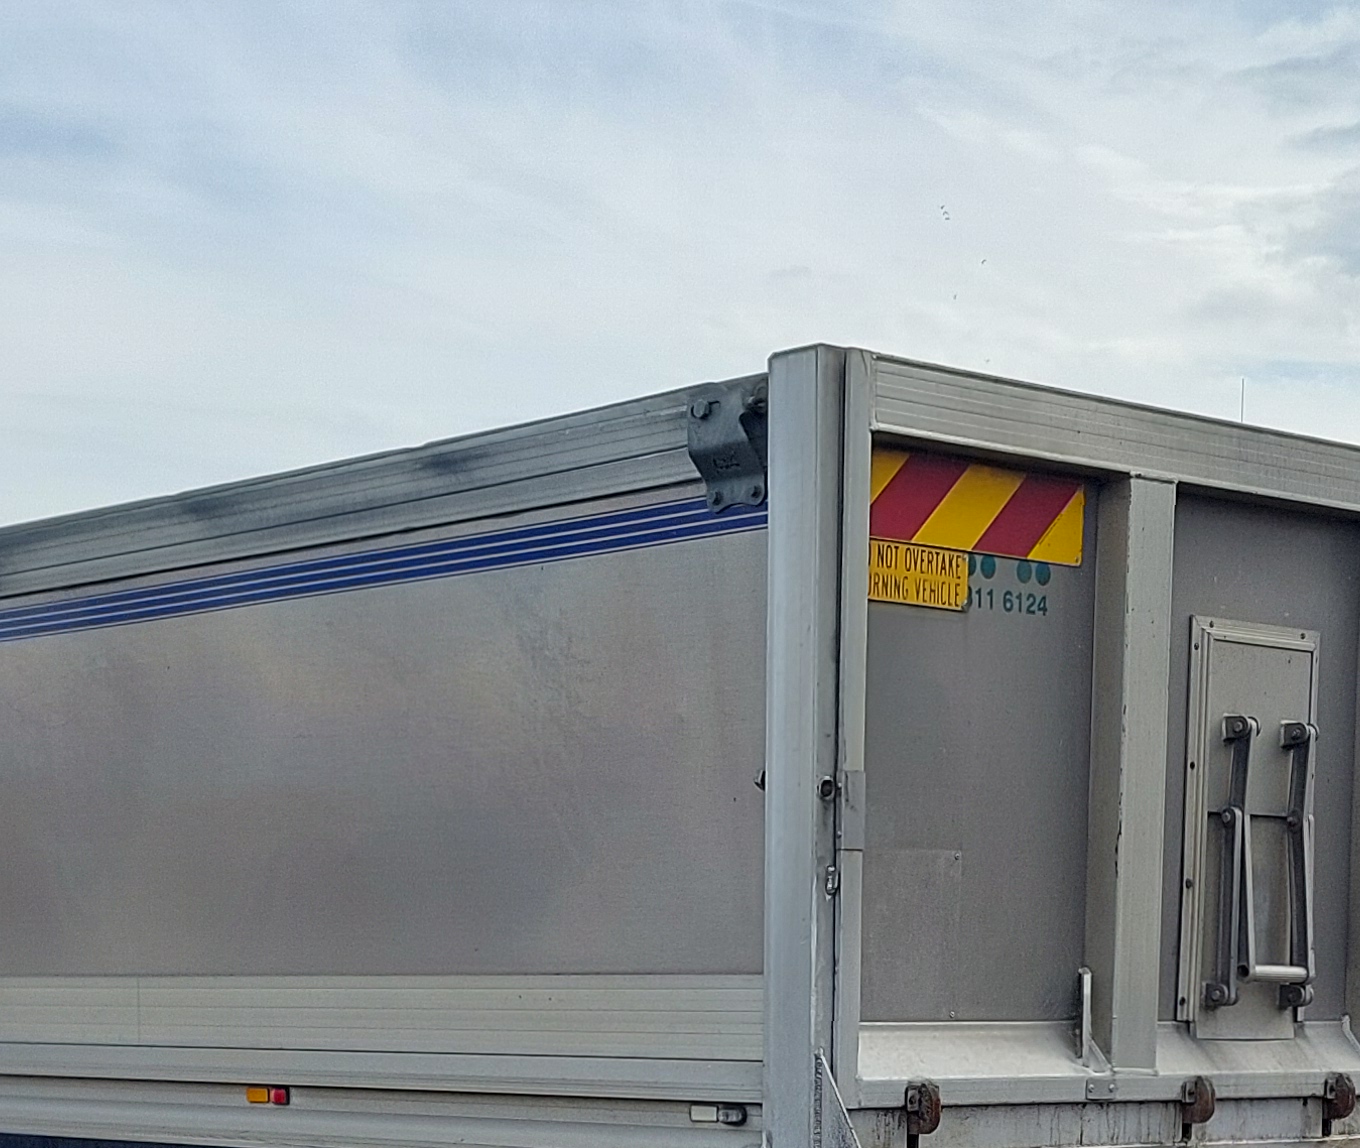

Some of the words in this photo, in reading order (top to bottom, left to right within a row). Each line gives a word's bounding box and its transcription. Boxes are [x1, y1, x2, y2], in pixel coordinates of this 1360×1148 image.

[877, 543, 900, 569] NOT
[904, 547, 962, 580] OVERTAKE
[914, 578, 961, 608] VEHICLE
[1003, 590, 1048, 616] 6124
